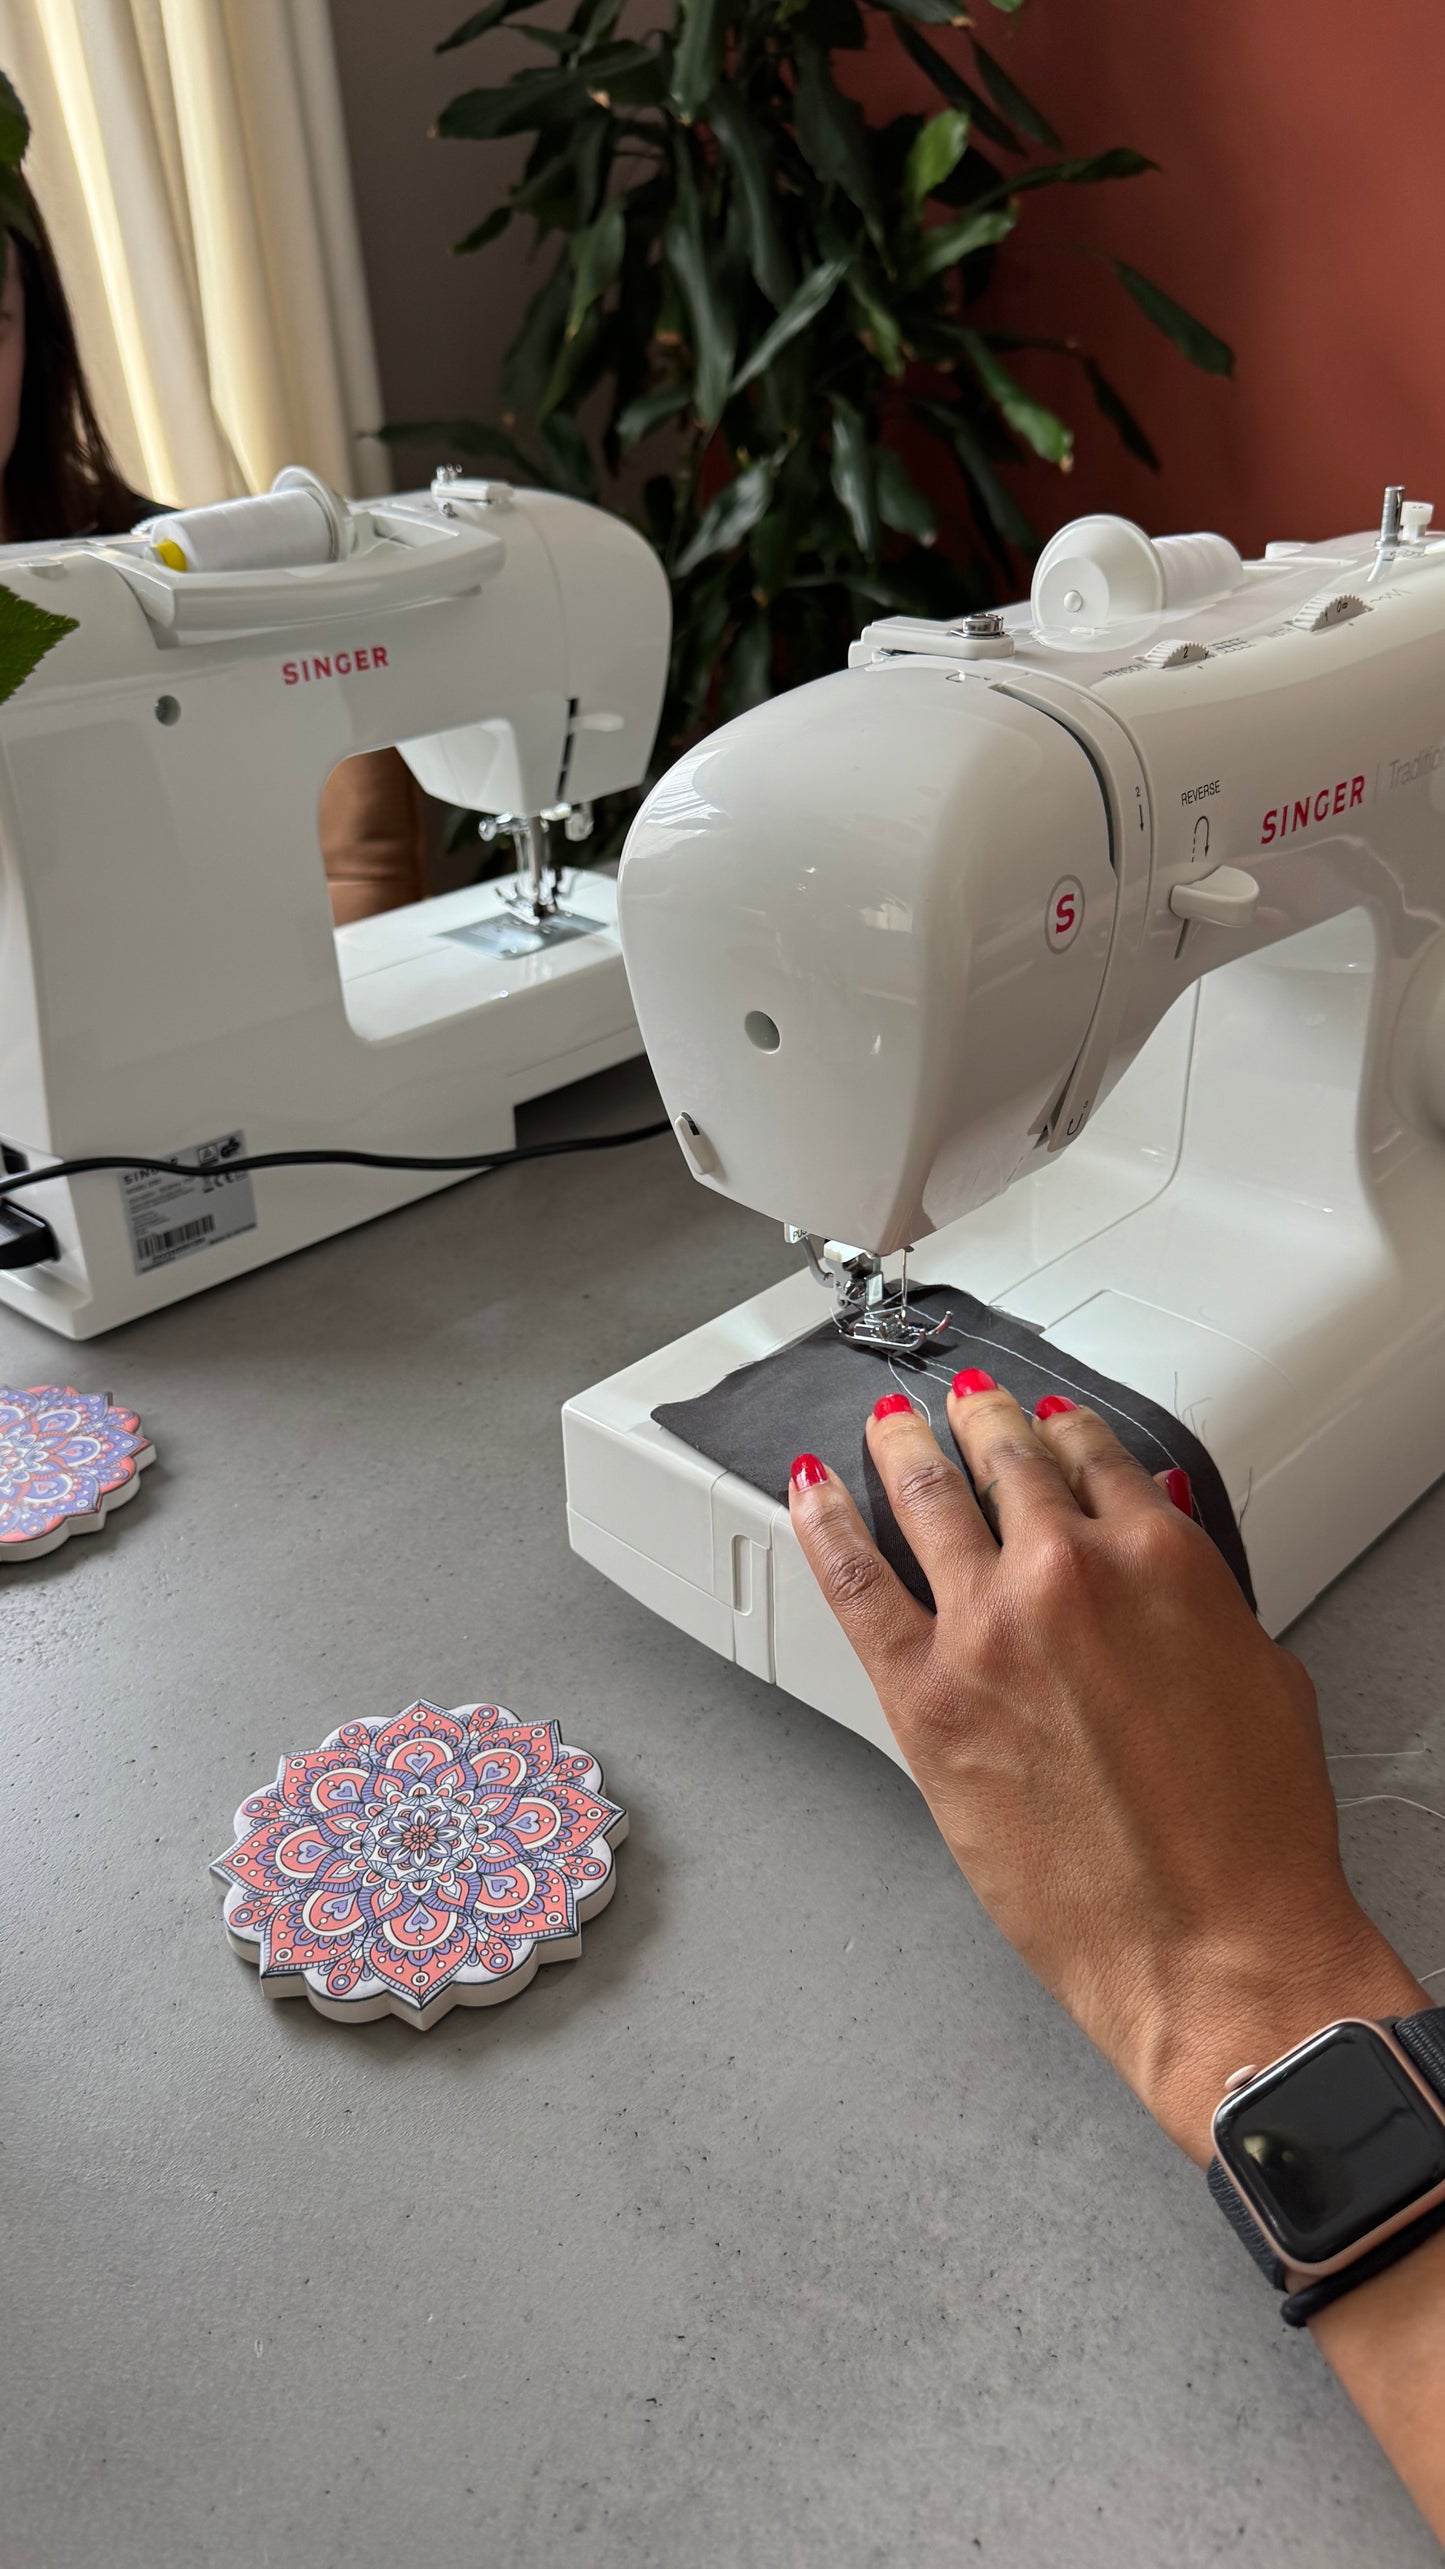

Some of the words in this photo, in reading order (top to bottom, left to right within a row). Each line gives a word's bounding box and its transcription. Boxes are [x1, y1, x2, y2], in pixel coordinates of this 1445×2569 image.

[1182, 645, 1189, 659] 2
[282, 646, 389, 686] SINGER
[1101, 663, 1148, 678] TENSION
[1134, 785, 1141, 798] 2
[1181, 779, 1222, 806] REVERSE
[1261, 775, 1365, 845] SINGER
[1055, 893, 1075, 935] S
